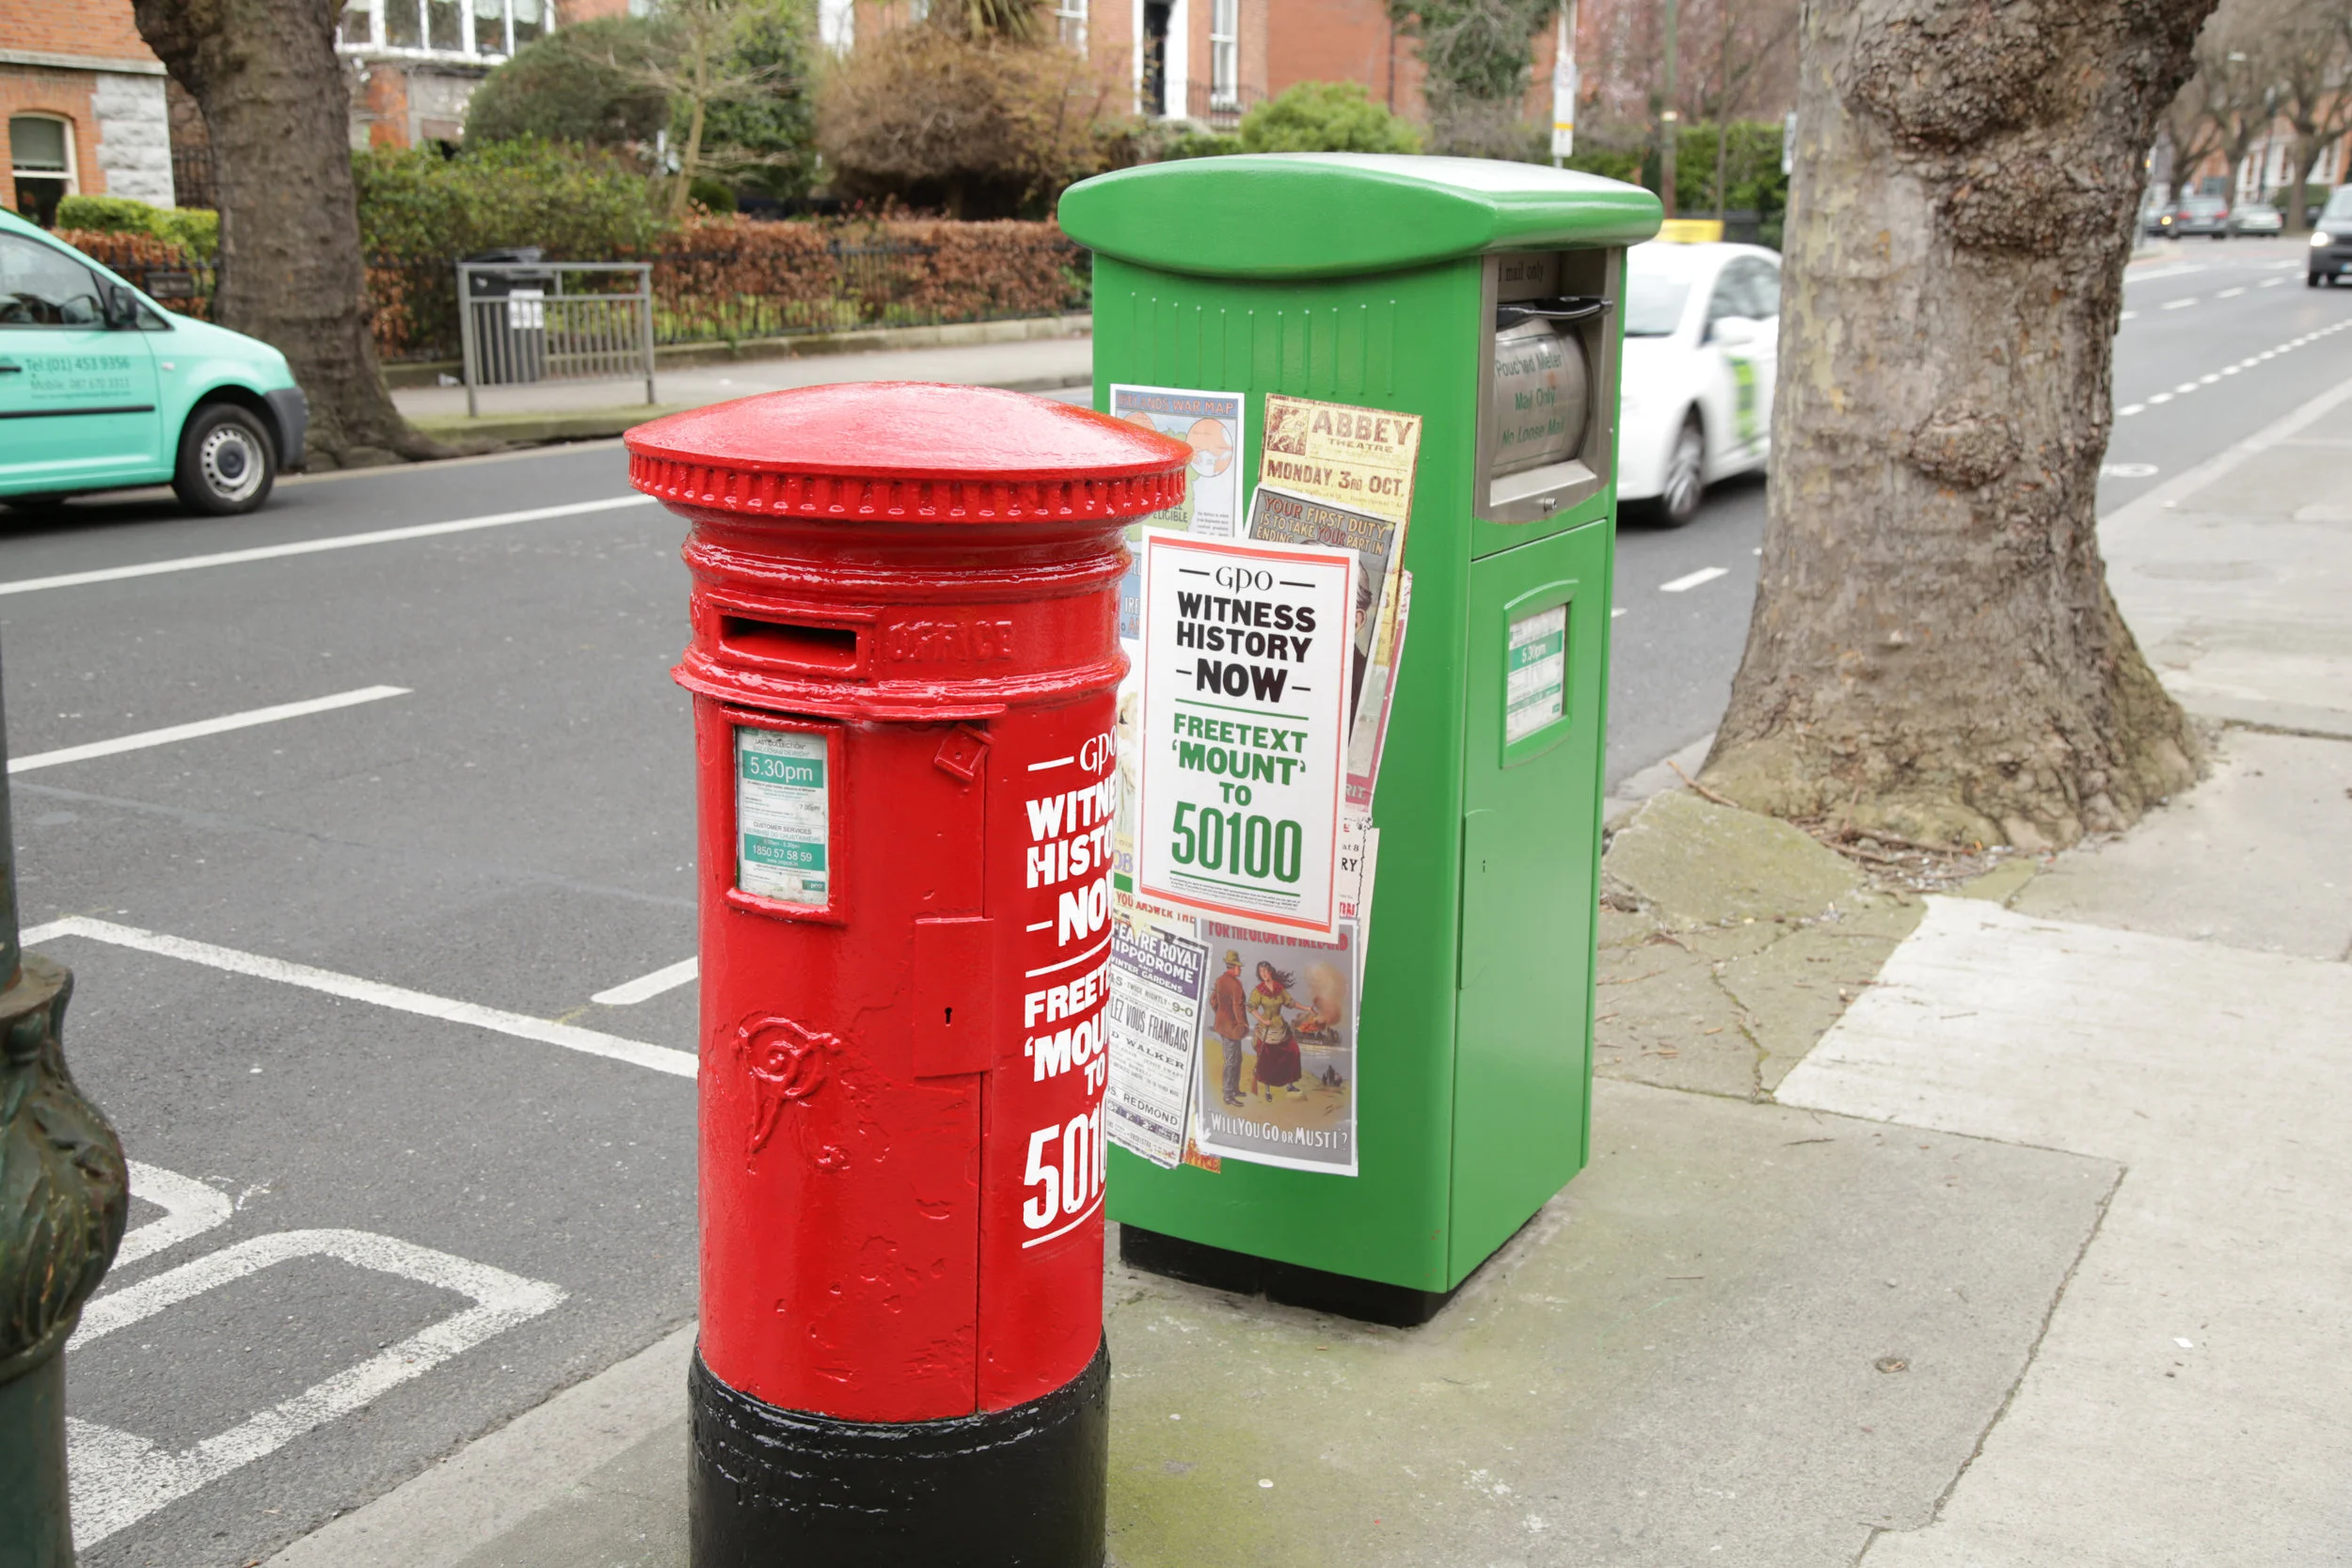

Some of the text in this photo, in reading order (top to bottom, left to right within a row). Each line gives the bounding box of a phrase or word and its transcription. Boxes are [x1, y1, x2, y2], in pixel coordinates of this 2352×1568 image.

[1505, 262, 1524, 281] mail
[1527, 261, 1544, 282] only
[1171, 399, 1201, 414] WAR
[1204, 402, 1234, 414] MAP
[1515, 388, 1556, 411] Mail Only
[1311, 409, 1414, 446] ABBEY
[1502, 430, 1515, 448] No
[1518, 424, 1545, 444] Loose
[1327, 438, 1393, 453] THEATRE
[1368, 474, 1405, 498] OCT.
[1263, 496, 1388, 540] YOUR FIRST DUTY
[1260, 512, 1385, 557] IS TO TAKE YOUR PART IN
[1177, 591, 1317, 634] WITNESS
[1176, 620, 1313, 664] HISTORY
[1197, 657, 1289, 704] NOW
[1173, 712, 1309, 754] FREETEXT
[750, 755, 814, 784] 5.30pm
[1218, 781, 1252, 807] TO
[754, 821, 813, 835] CUSTOMER SERVICES
[1171, 800, 1303, 884] 50100
[753, 845, 813, 863] 1850 57 58 59
[1117, 891, 1134, 908] YOU
[1160, 940, 1200, 972] ROYAL
[1126, 1003, 1147, 1034] VOUS
[1171, 1001, 1195, 1019] 9-0
[1126, 1037, 1185, 1070] WALKER
[1084, 1052, 1106, 1096] TO
[1123, 1093, 1179, 1127] REDMOND
[1238, 1117, 1261, 1139] YOU
[1262, 1122, 1279, 1142] GO
[1281, 1130, 1295, 1145] OR
[1295, 1127, 1328, 1148] MUST
